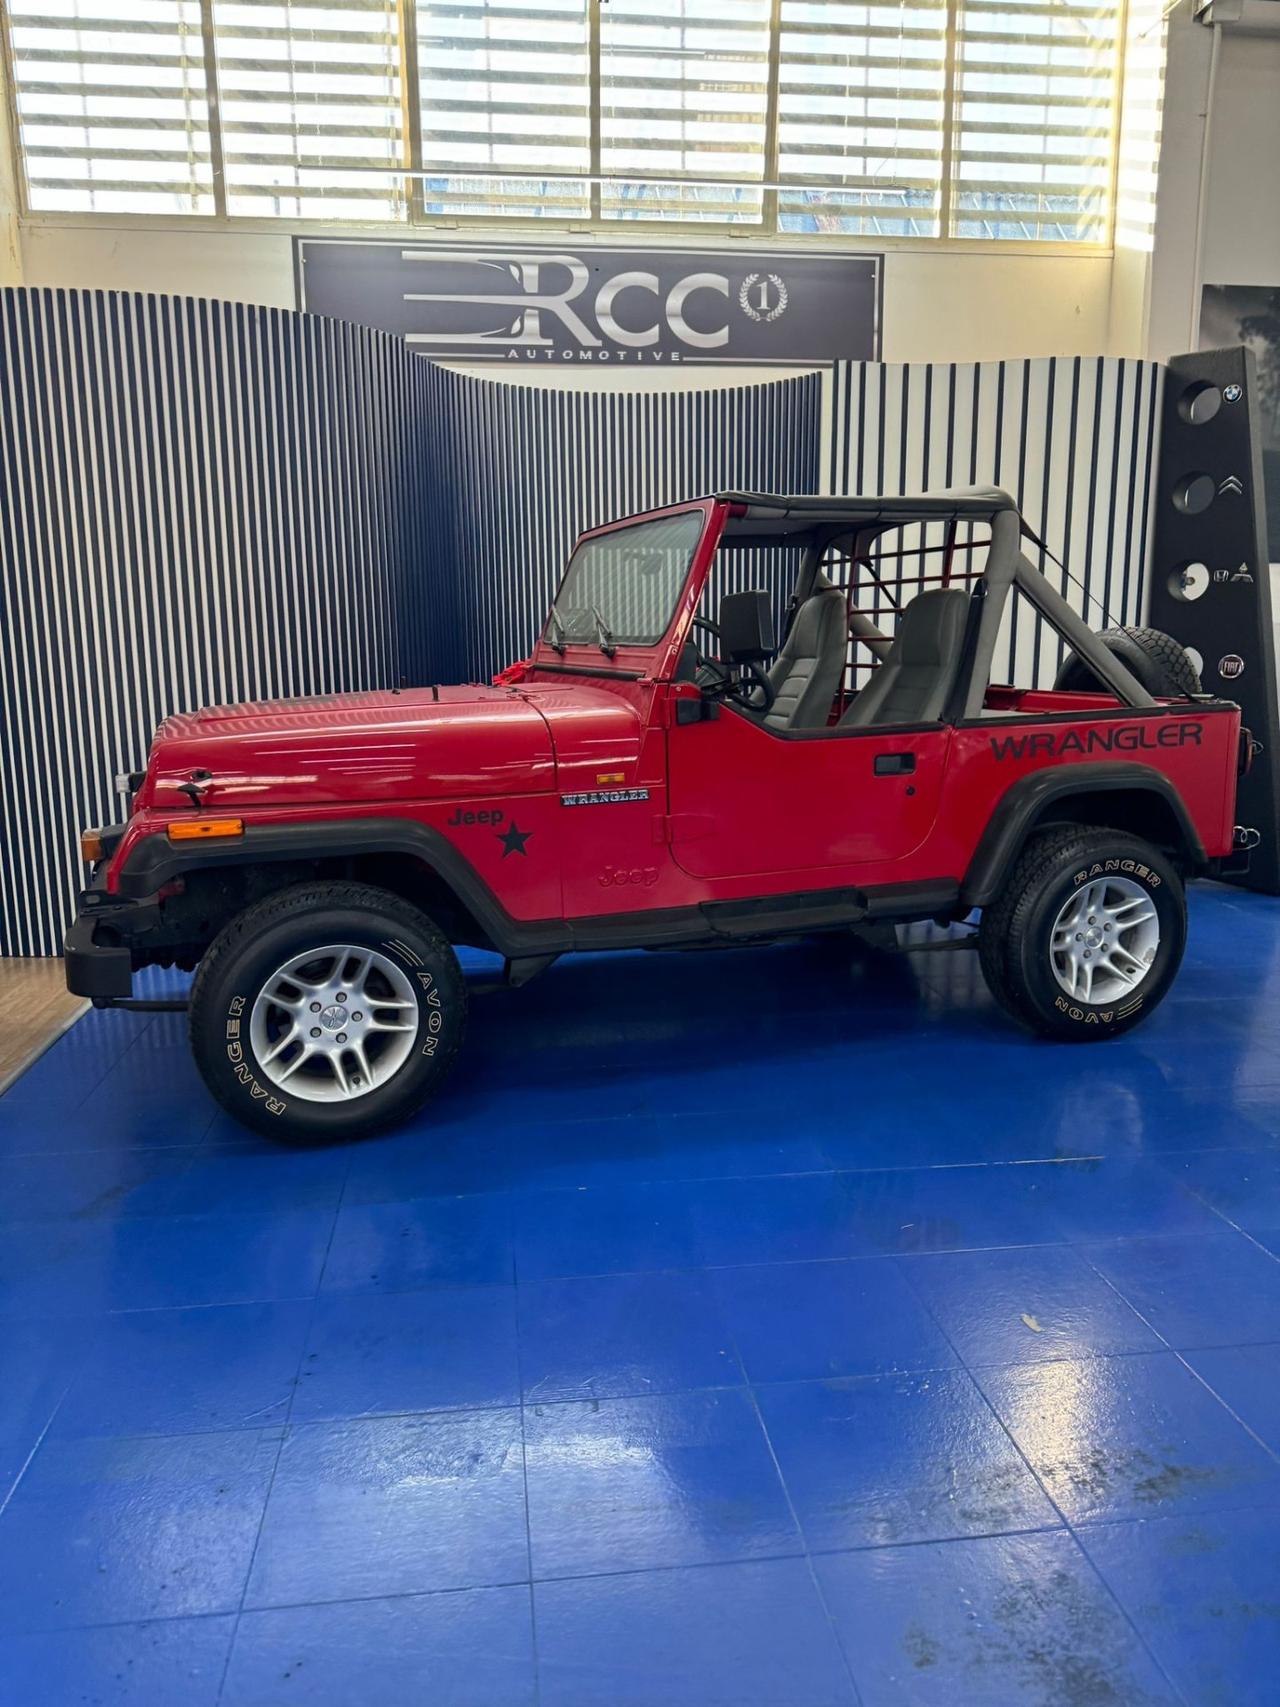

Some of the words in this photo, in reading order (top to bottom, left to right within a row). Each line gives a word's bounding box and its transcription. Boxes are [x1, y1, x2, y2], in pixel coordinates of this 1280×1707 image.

[402, 250, 730, 348] RCC
[508, 348, 681, 362] AUTOMOTIVE
[990, 722, 1203, 762] WRANGLER
[562, 789, 649, 806] WRANGLER
[448, 808, 504, 827] Jeep
[598, 865, 660, 888] Jeep
[1073, 859, 1161, 888] RANGER
[416, 971, 442, 1056] AVON
[1054, 996, 1114, 1024] AVON
[226, 995, 287, 1116] RANGER
